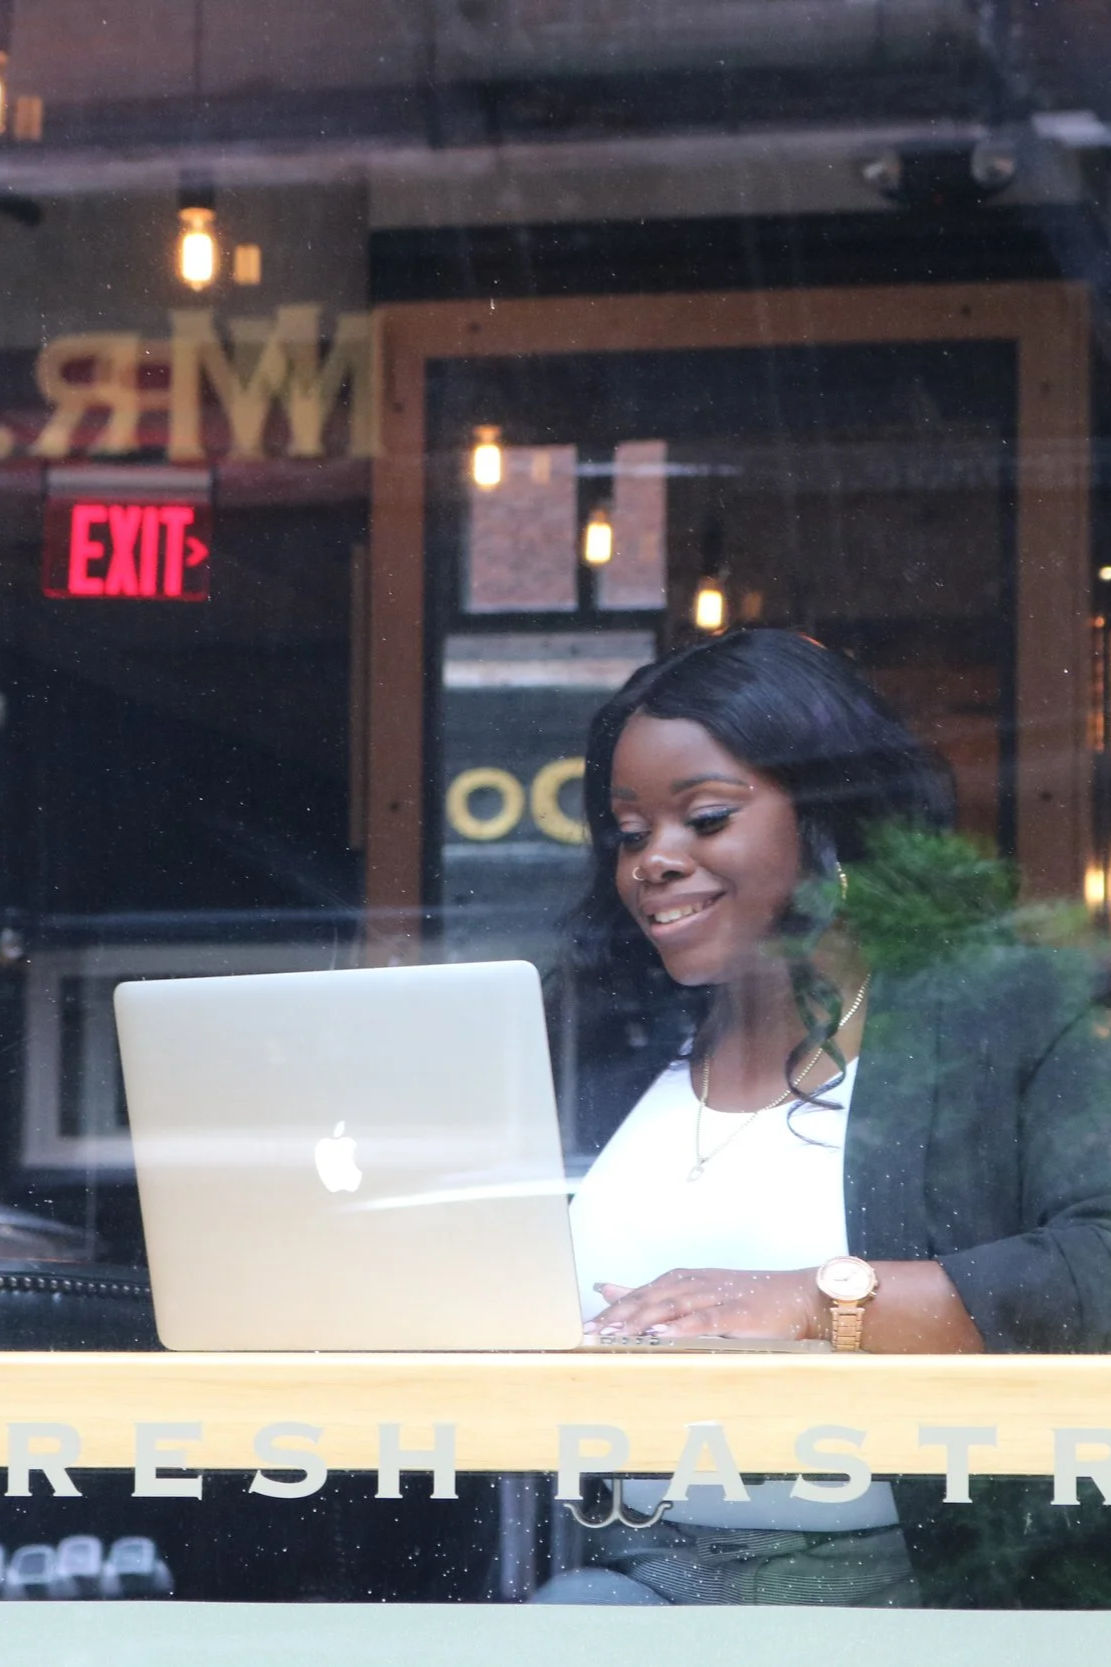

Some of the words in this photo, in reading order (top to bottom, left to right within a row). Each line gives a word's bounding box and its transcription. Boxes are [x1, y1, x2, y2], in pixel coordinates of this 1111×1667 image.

[68, 504, 195, 597] EXIT
[5, 1420, 459, 1500] RESH
[555, 1422, 1111, 1506] PASTR
